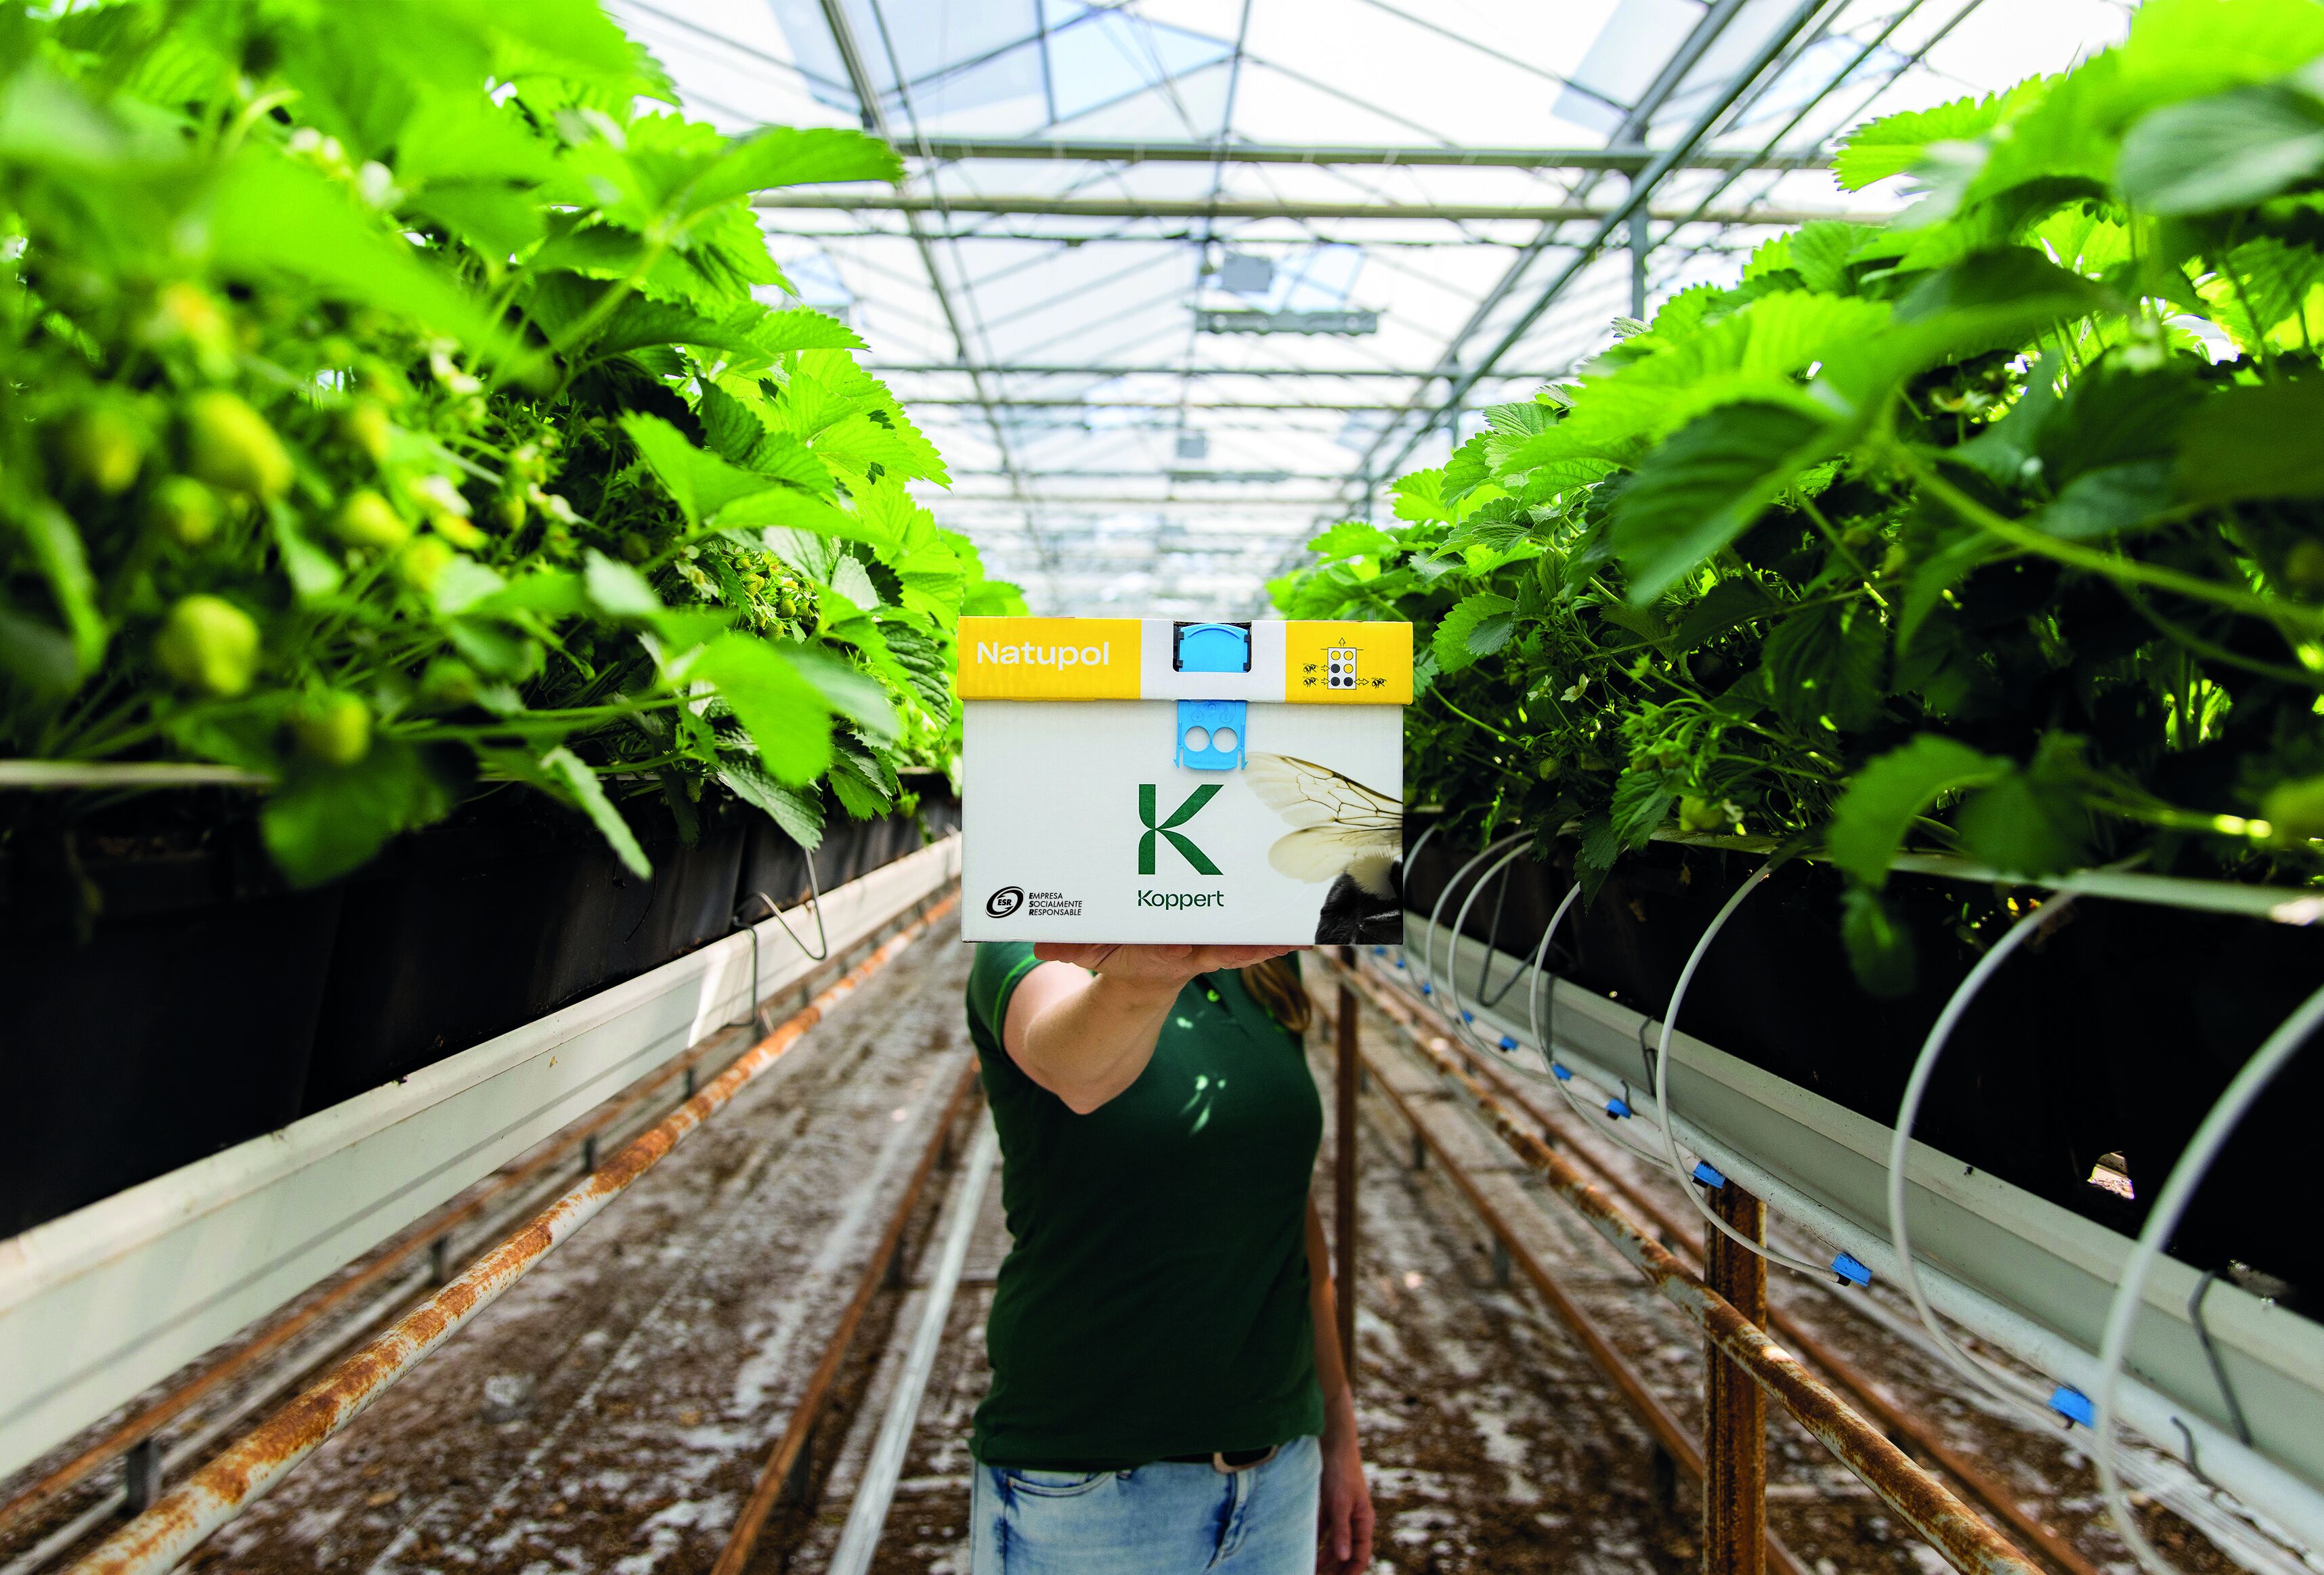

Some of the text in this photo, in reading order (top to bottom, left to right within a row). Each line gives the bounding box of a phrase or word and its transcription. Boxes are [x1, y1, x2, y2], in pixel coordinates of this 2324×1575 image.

[976, 641, 1109, 671] Natupol
[1138, 783, 1224, 876] K
[1138, 890, 1224, 911] Koppert
